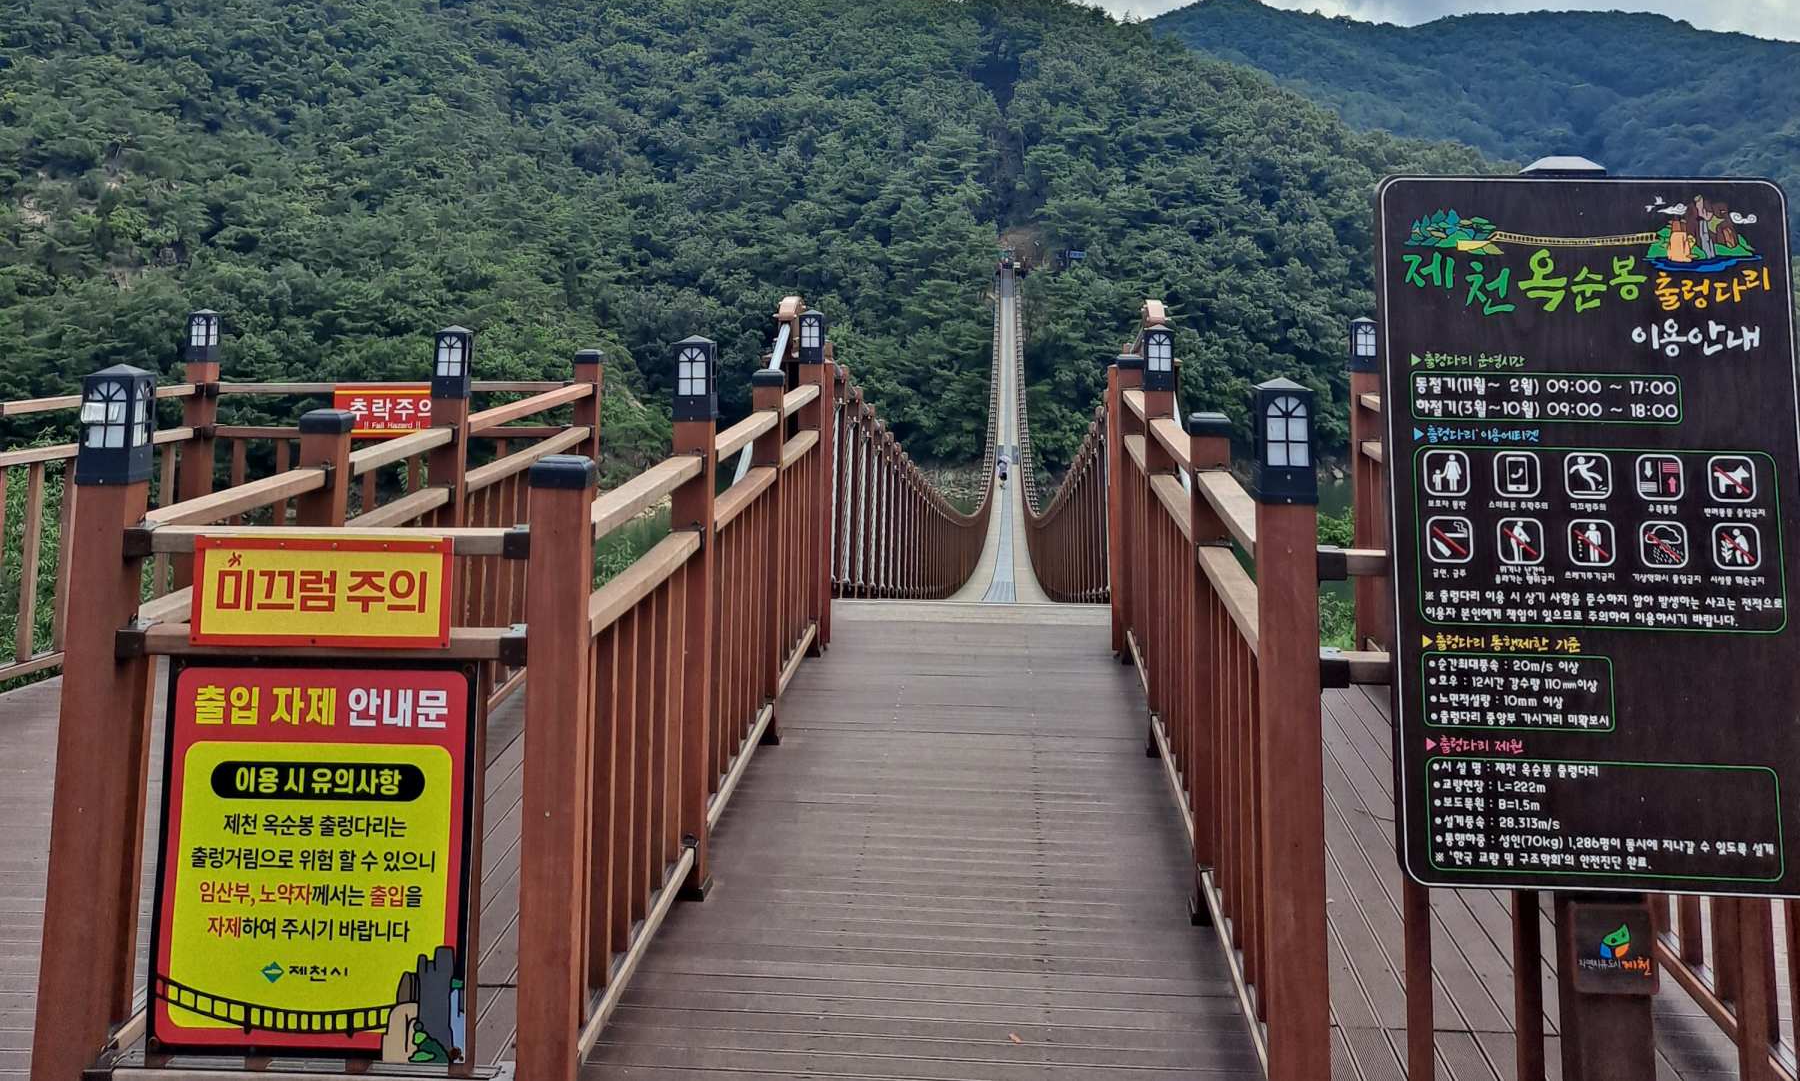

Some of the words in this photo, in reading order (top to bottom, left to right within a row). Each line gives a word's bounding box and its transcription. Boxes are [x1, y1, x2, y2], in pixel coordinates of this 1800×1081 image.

[1402, 251, 1517, 316] 제천
[1517, 248, 1648, 313] 옥순봉
[1654, 266, 1771, 311] 출렁다리
[1631, 318, 1760, 357] 이용안내
[1424, 351, 1472, 368] 출렁다리
[1477, 352, 1526, 368] 운영시간
[1546, 379, 1601, 394] 09:00
[1630, 380, 1676, 395] 17:00
[1547, 402, 1602, 417] 09:00
[1630, 403, 1678, 418] 18:00
[371, 421, 384, 429] Fall
[387, 421, 412, 429] Hazard
[1427, 425, 1475, 443] 출렁다리
[1480, 427, 1540, 443] 이용에티켓
[1439, 590, 1480, 603] 출렁다리
[1486, 591, 1504, 604] 이용
[1510, 592, 1520, 602] 시
[1525, 592, 1545, 605] 상기
[1550, 592, 1580, 606] 사항을
[1586, 593, 1627, 607] 준수하지
[1658, 596, 1700, 610] 발생하는
[1705, 597, 1736, 611] 사고는
[1742, 598, 1783, 611] 전적으로
[1425, 606, 1456, 620] 이용자
[1461, 607, 1501, 621] 본인에게
[1506, 608, 1537, 622] 책임이
[1588, 611, 1630, 623] 주의하여
[1634, 611, 1688, 626] 이용하시기
[1692, 613, 1738, 627] 바랍니다.
[1436, 632, 1485, 651] 출렁다리
[1490, 634, 1549, 651] 통행제한
[1555, 636, 1581, 653] 기준
[1438, 657, 1500, 672] 순간최대풍속
[1512, 659, 1553, 673] 20m/s
[1558, 661, 1580, 674] 이상
[1472, 677, 1504, 690] 12시간
[1510, 678, 1540, 691] 강수량
[194, 684, 260, 725] 출입
[270, 687, 337, 726] 자제
[348, 688, 448, 728] 안내문
[1440, 693, 1490, 707] 노면적설량
[1504, 695, 1537, 707] 10mm
[1543, 697, 1564, 709] 이상
[1440, 710, 1480, 725] 출렁다리
[1486, 711, 1516, 725] 중앙부
[1522, 713, 1562, 725] 가시거리
[1440, 735, 1488, 753] 출렁다리
[1494, 738, 1524, 754] 제원
[235, 766, 278, 793] 이용
[284, 768, 305, 793] 시
[311, 768, 402, 795] 유의사항
[1522, 764, 1552, 778] 옥순봉
[1558, 765, 1598, 779] 출렁다리
[1442, 780, 1485, 793] 교량연장
[1498, 781, 1546, 793] L=222m
[1498, 799, 1540, 811] B=1.5m
[224, 814, 257, 835] 제천
[263, 815, 314, 837] 옥순봉
[320, 816, 407, 837] 출렁다리는
[1444, 815, 1486, 829] 설계풍속
[1499, 817, 1560, 831] 28.313m/s
[1500, 835, 1564, 849] 성인(70kg)
[1568, 837, 1620, 851] 1,286명이
[1626, 839, 1658, 853] 동시에
[1662, 840, 1696, 855] 지나갈
[1700, 841, 1710, 853] 수
[1752, 843, 1774, 857] 설계
[191, 847, 294, 869] 출렁거림으로
[299, 850, 333, 871] 위험
[339, 850, 356, 871] 할
[361, 851, 378, 871] 수
[383, 851, 436, 872] 있으니
[1479, 852, 1499, 866] 교량
[1504, 853, 1514, 867] 및
[1580, 856, 1622, 869] 안전진단
[1626, 857, 1652, 870] 완료.
[200, 882, 255, 907] 임산부,
[259, 884, 364, 907] 노약자께서는
[370, 886, 422, 908] 출입을
[207, 916, 276, 939] 자제하여
[282, 919, 333, 941] 주시기
[339, 921, 409, 942] 바랍니다
[289, 966, 348, 982] 제천시
